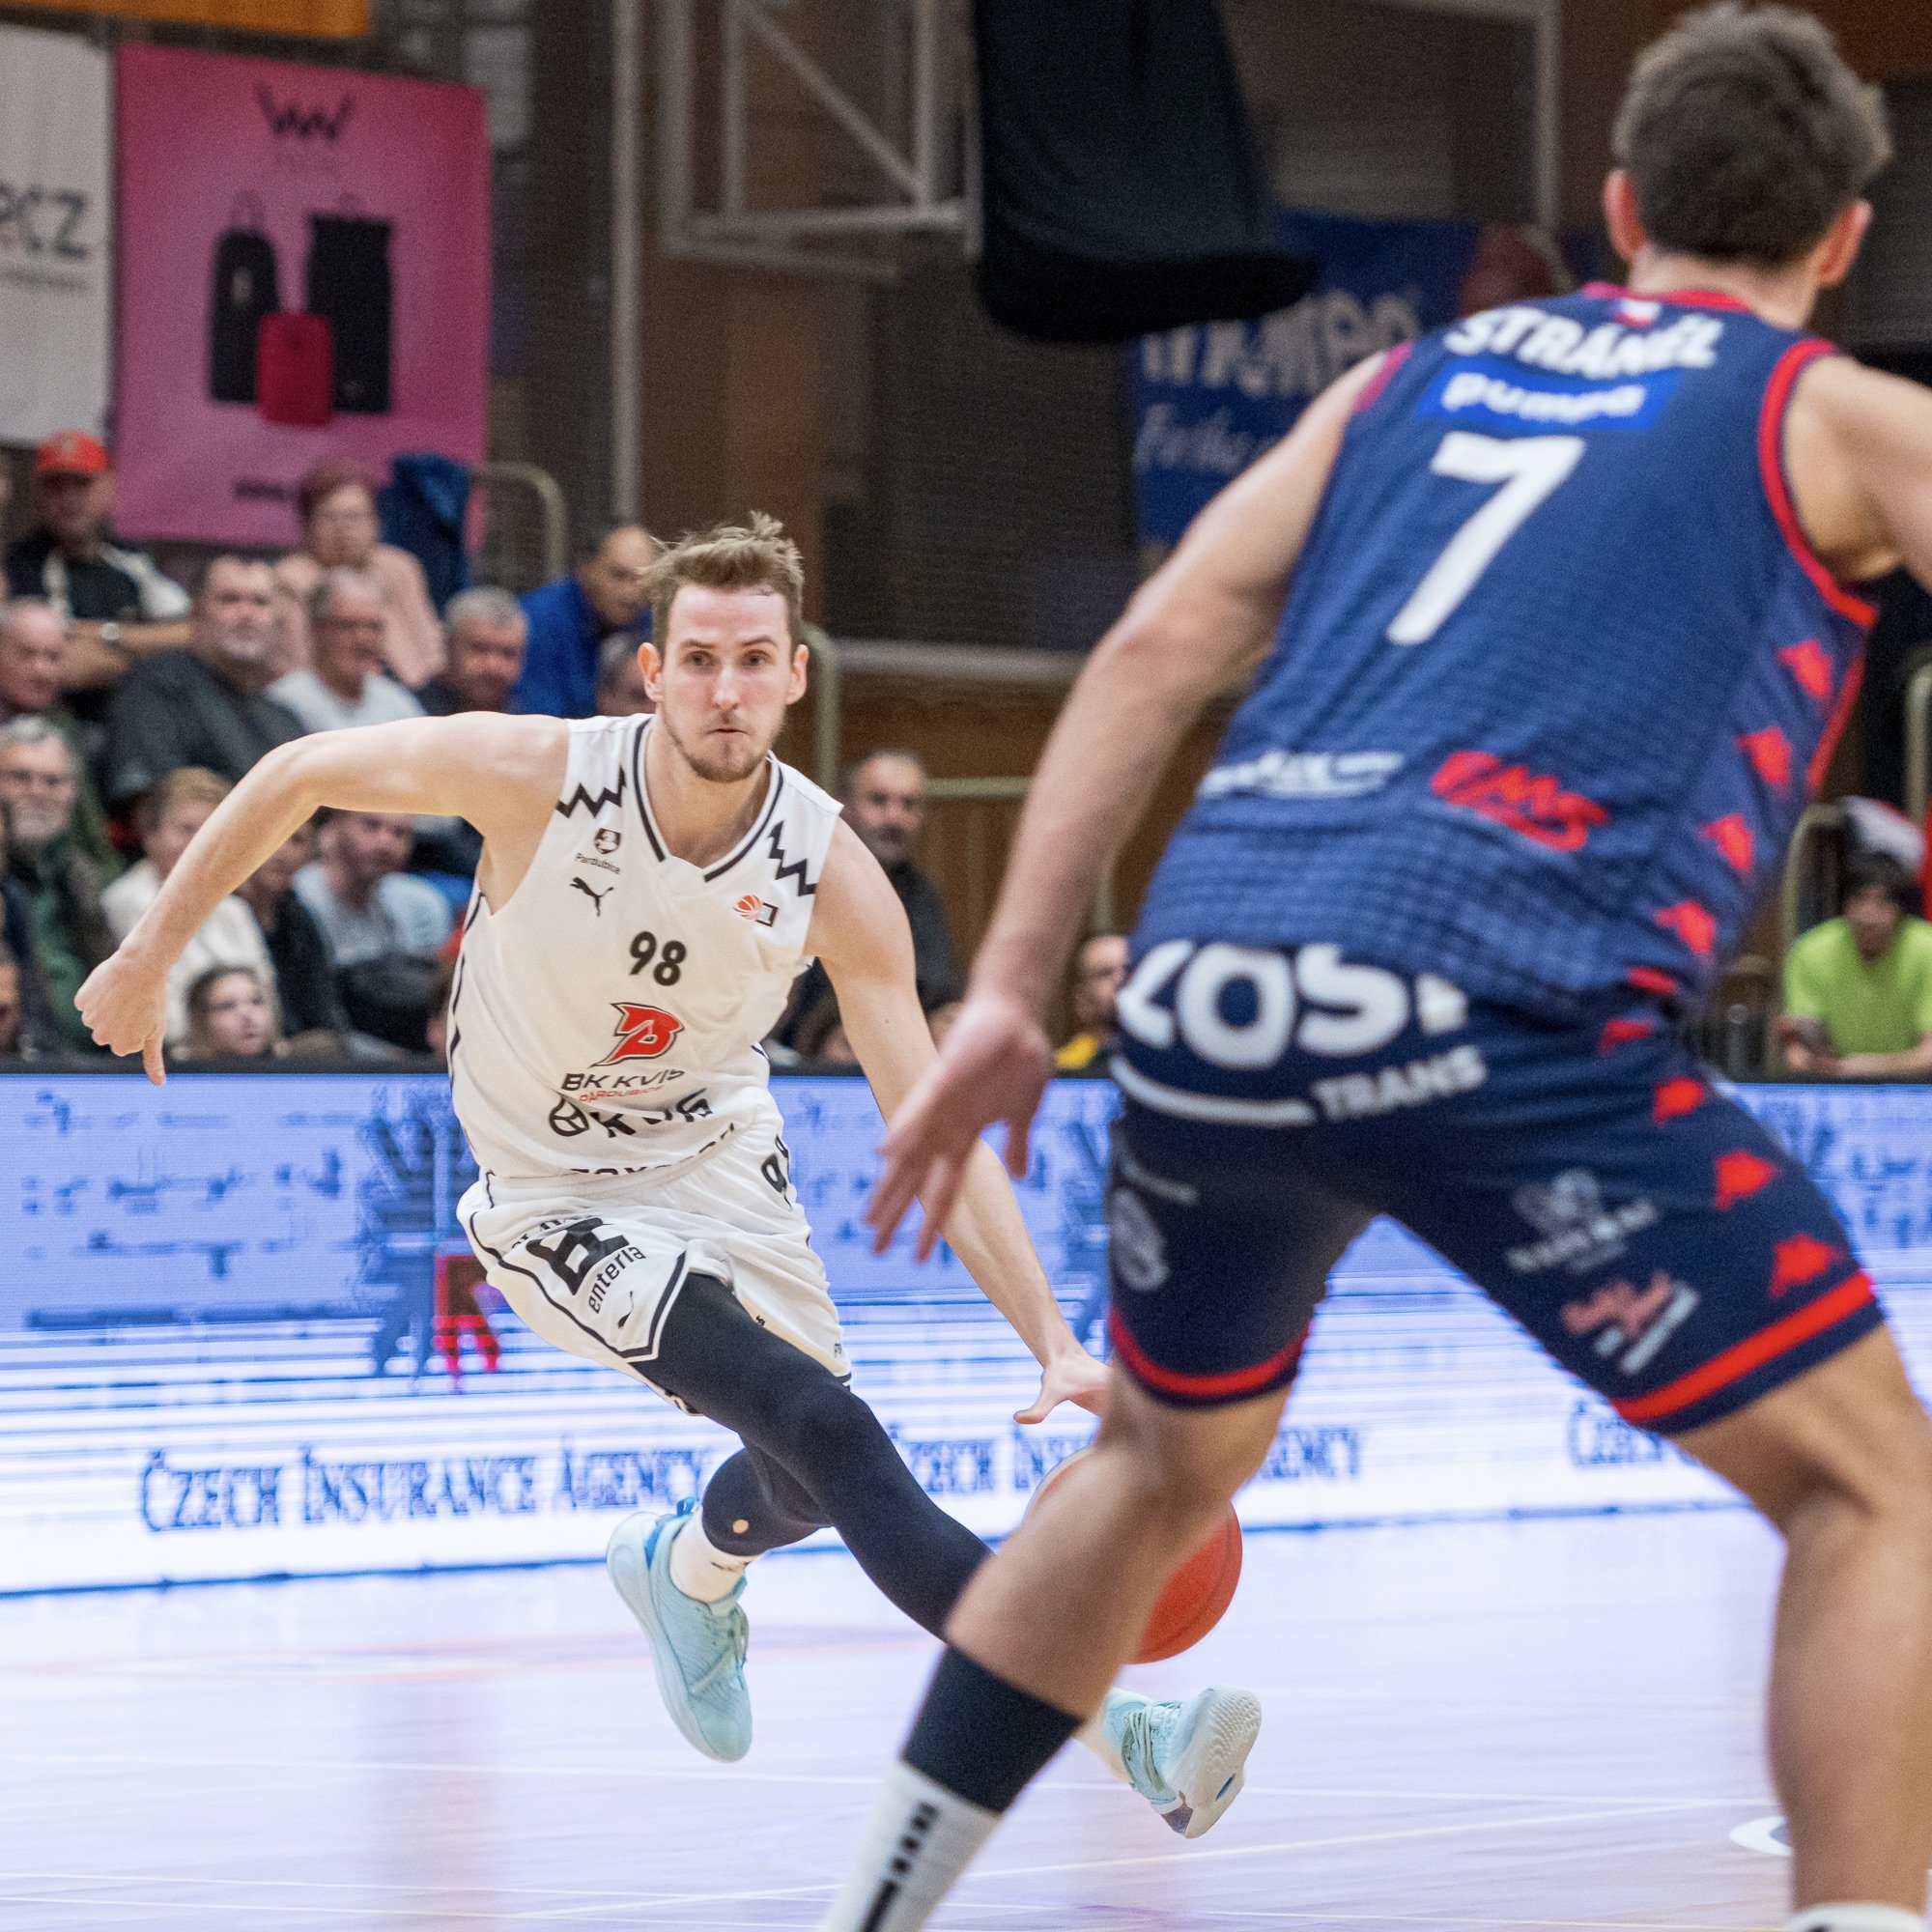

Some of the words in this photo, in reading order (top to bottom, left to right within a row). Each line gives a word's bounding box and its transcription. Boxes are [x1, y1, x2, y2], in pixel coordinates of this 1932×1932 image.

[1386, 430, 1585, 646] 7
[629, 930, 687, 986] 98
[560, 1072, 611, 1092] BK
[1312, 1044, 1489, 1122] TRANS
[587, 1246, 646, 1314] enteria
